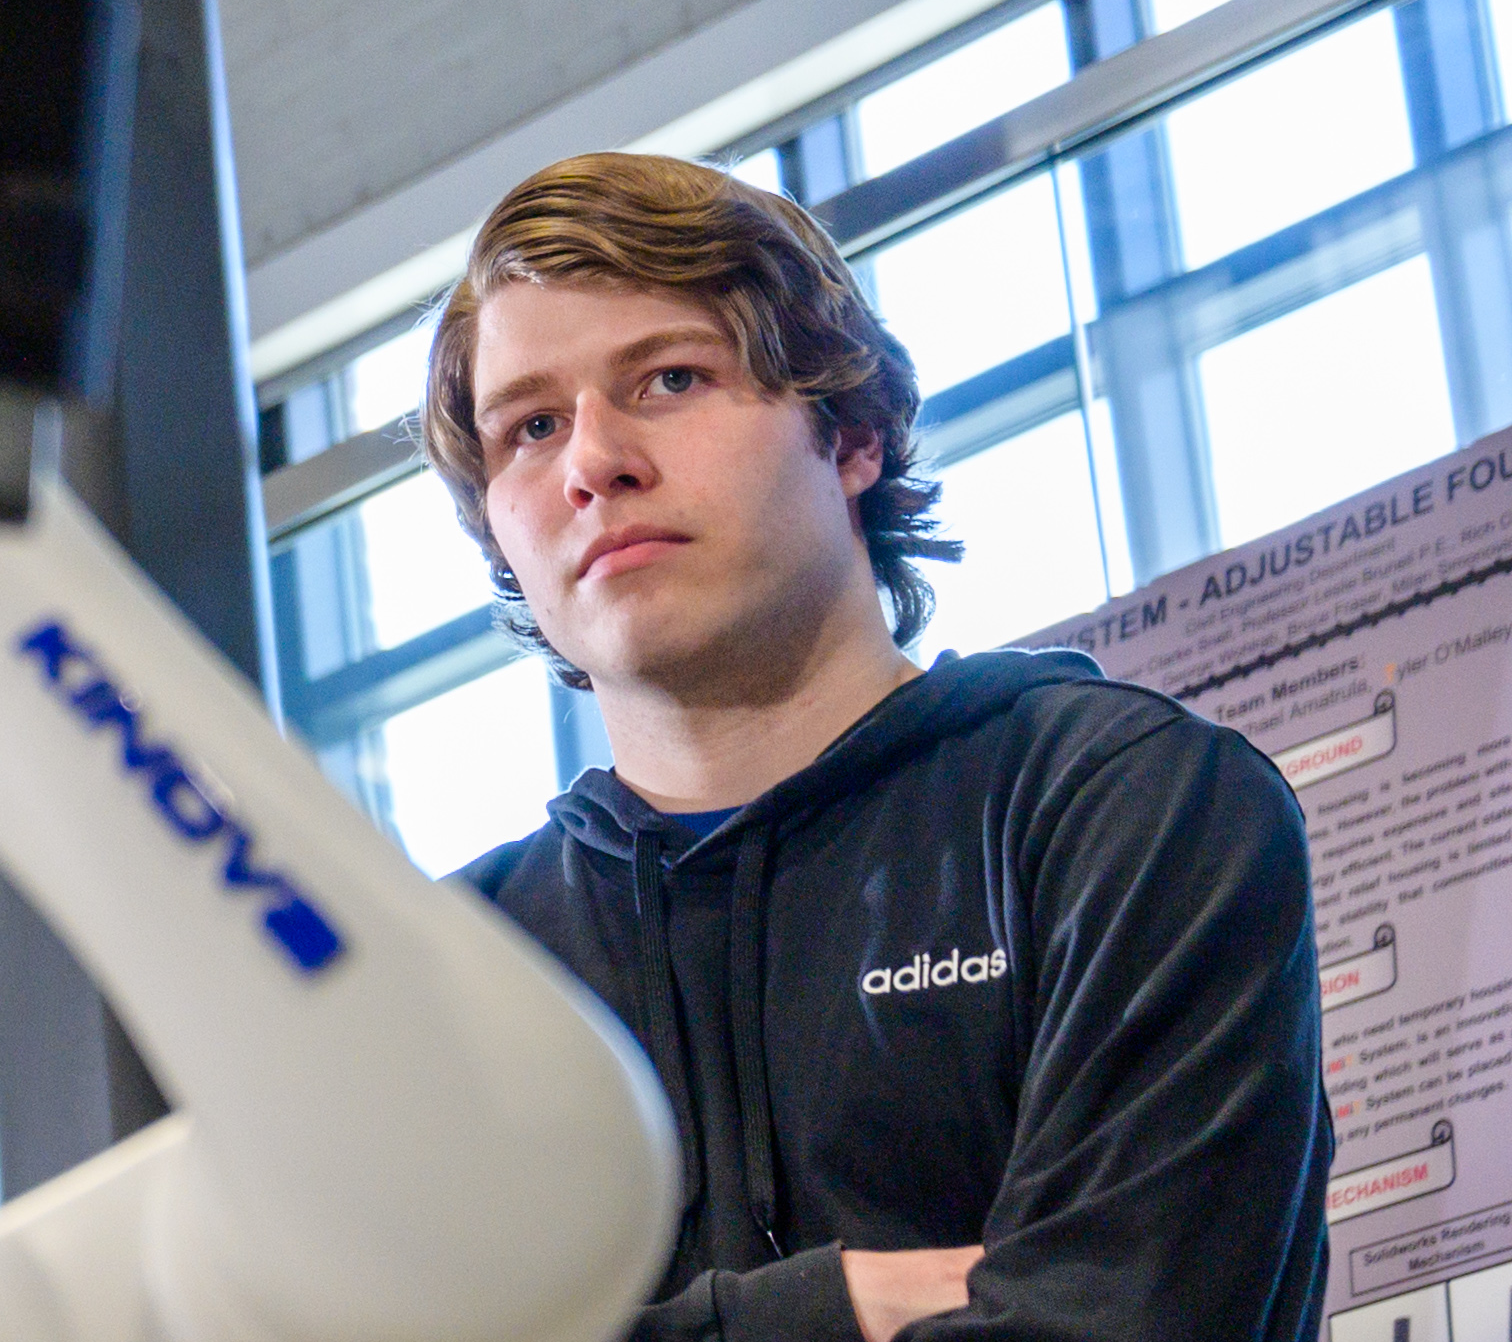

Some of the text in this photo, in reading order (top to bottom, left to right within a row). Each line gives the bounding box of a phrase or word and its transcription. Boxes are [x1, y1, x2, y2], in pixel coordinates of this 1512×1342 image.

[1199, 481, 1434, 607] ADJUSTABLE
[1221, 580, 1306, 621] Engineering
[1310, 538, 1396, 582] Department
[1217, 691, 1264, 723] Team
[1281, 734, 1363, 780] GROUND
[1402, 753, 1467, 784] becoming
[1426, 772, 1480, 801] problem
[1456, 792, 1482, 811] and
[1402, 838, 1425, 856] The
[862, 947, 1007, 995] adidas
[1398, 994, 1465, 1027] temporary
[1434, 1023, 1451, 1039] an
[1374, 1060, 1413, 1083] which
[1417, 1049, 1441, 1067] will
[1446, 1037, 1483, 1059] serve
[1489, 1030, 1505, 1045] as
[1365, 1084, 1415, 1110] System
[1418, 1075, 1443, 1093] can
[1446, 1067, 1463, 1083] be
[1467, 1050, 1512, 1078] placed
[1346, 1124, 1370, 1141] any
[1374, 1097, 1445, 1134] permanent
[1441, 1212, 1512, 1241] Rendering
